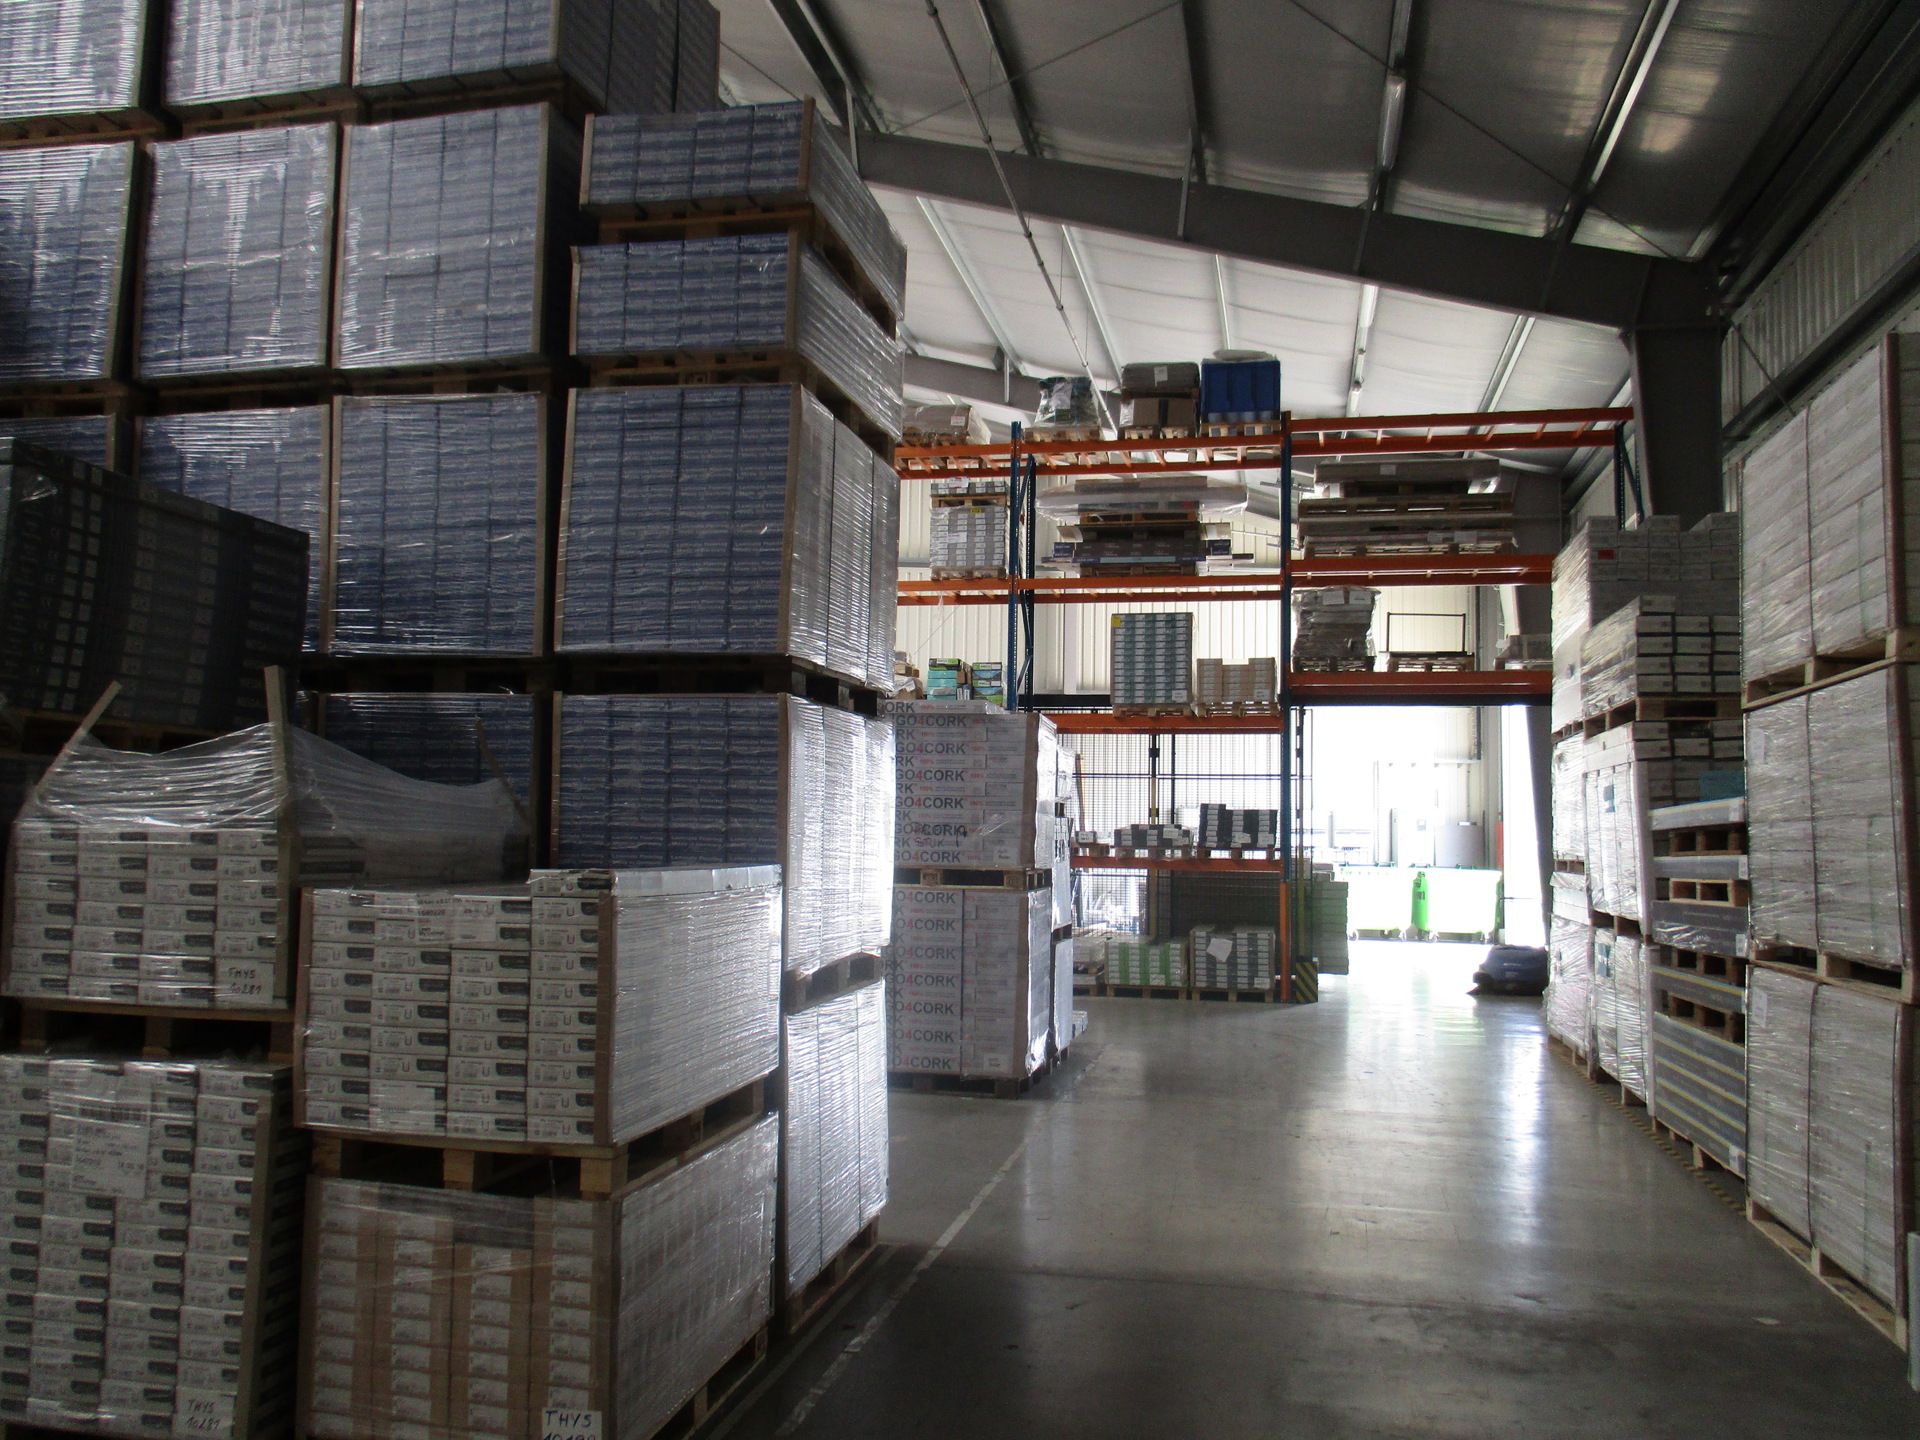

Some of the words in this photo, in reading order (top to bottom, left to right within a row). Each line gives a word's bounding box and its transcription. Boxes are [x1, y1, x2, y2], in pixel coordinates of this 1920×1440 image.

[896, 714, 967, 728] GO4CORK
[896, 742, 966, 754] GO4CORK
[545, 1410, 592, 1428] THYS
